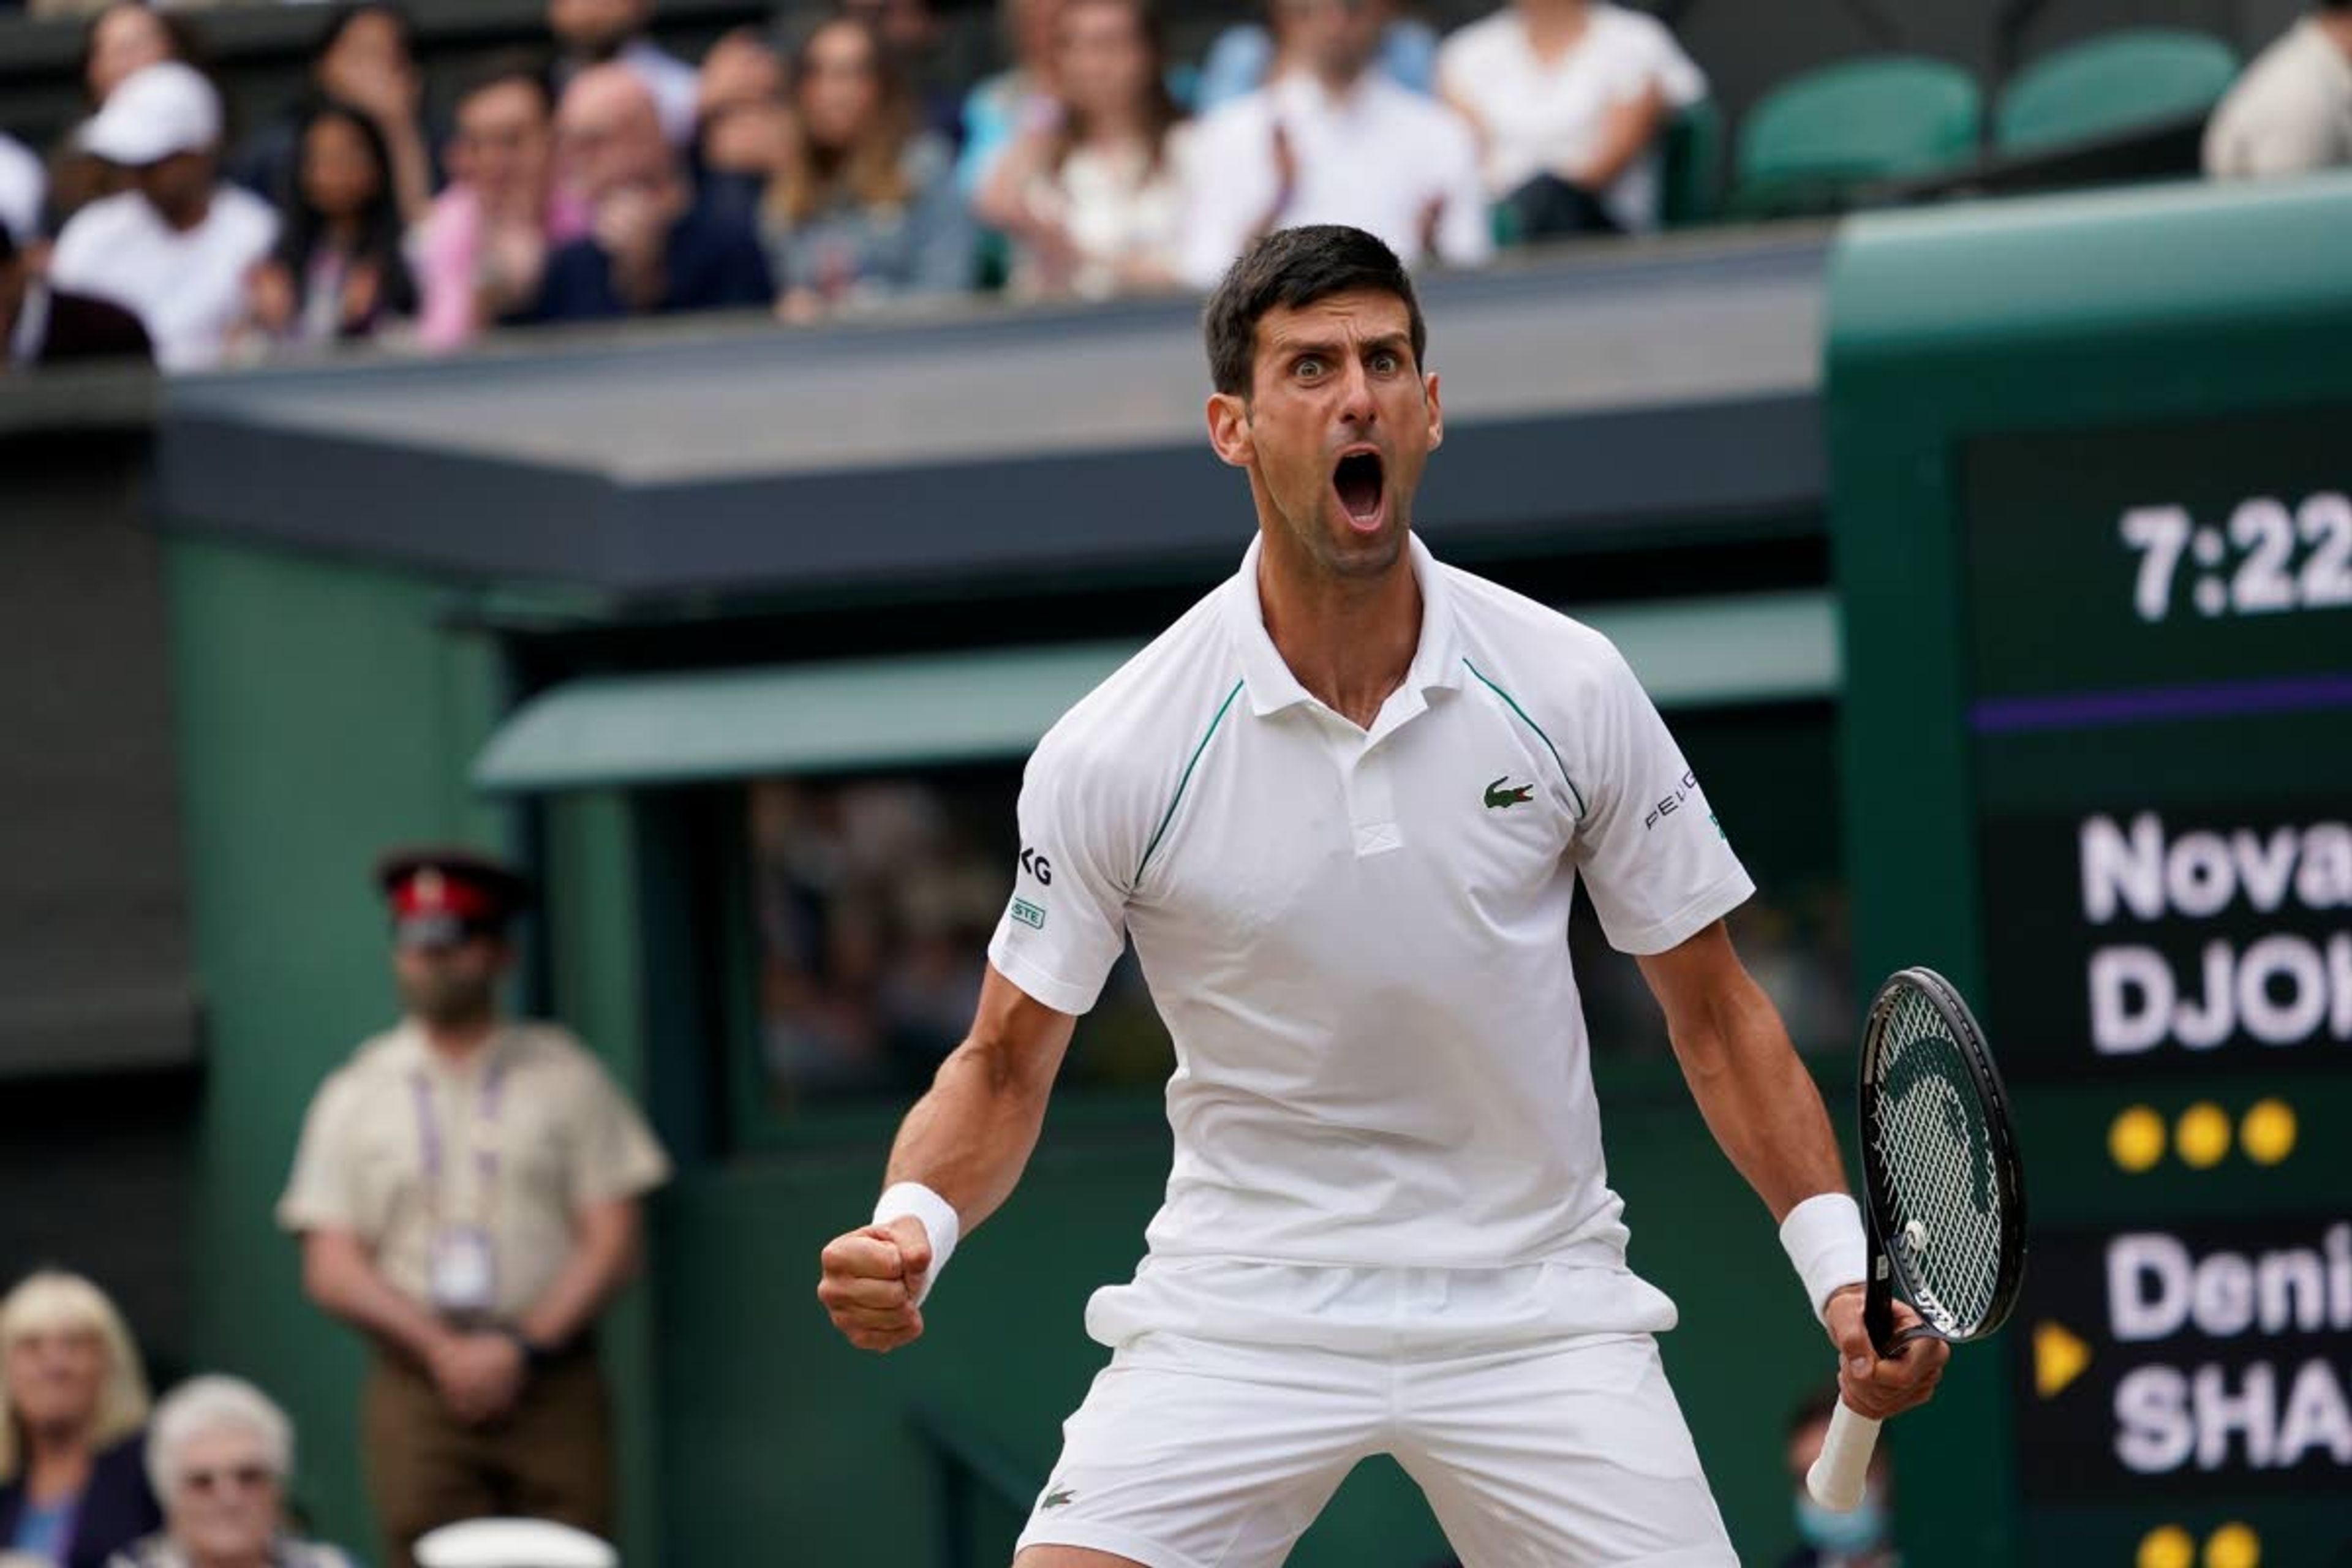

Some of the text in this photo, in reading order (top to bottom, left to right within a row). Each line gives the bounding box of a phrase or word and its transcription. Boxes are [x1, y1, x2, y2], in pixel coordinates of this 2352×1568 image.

[2120, 492, 2352, 621] 7:22
[1011, 903, 1040, 924] STE
[2081, 812, 2352, 922] Nova
[2106, 1223, 2352, 1341] Deni
[2114, 1359, 2352, 1473] SHA
